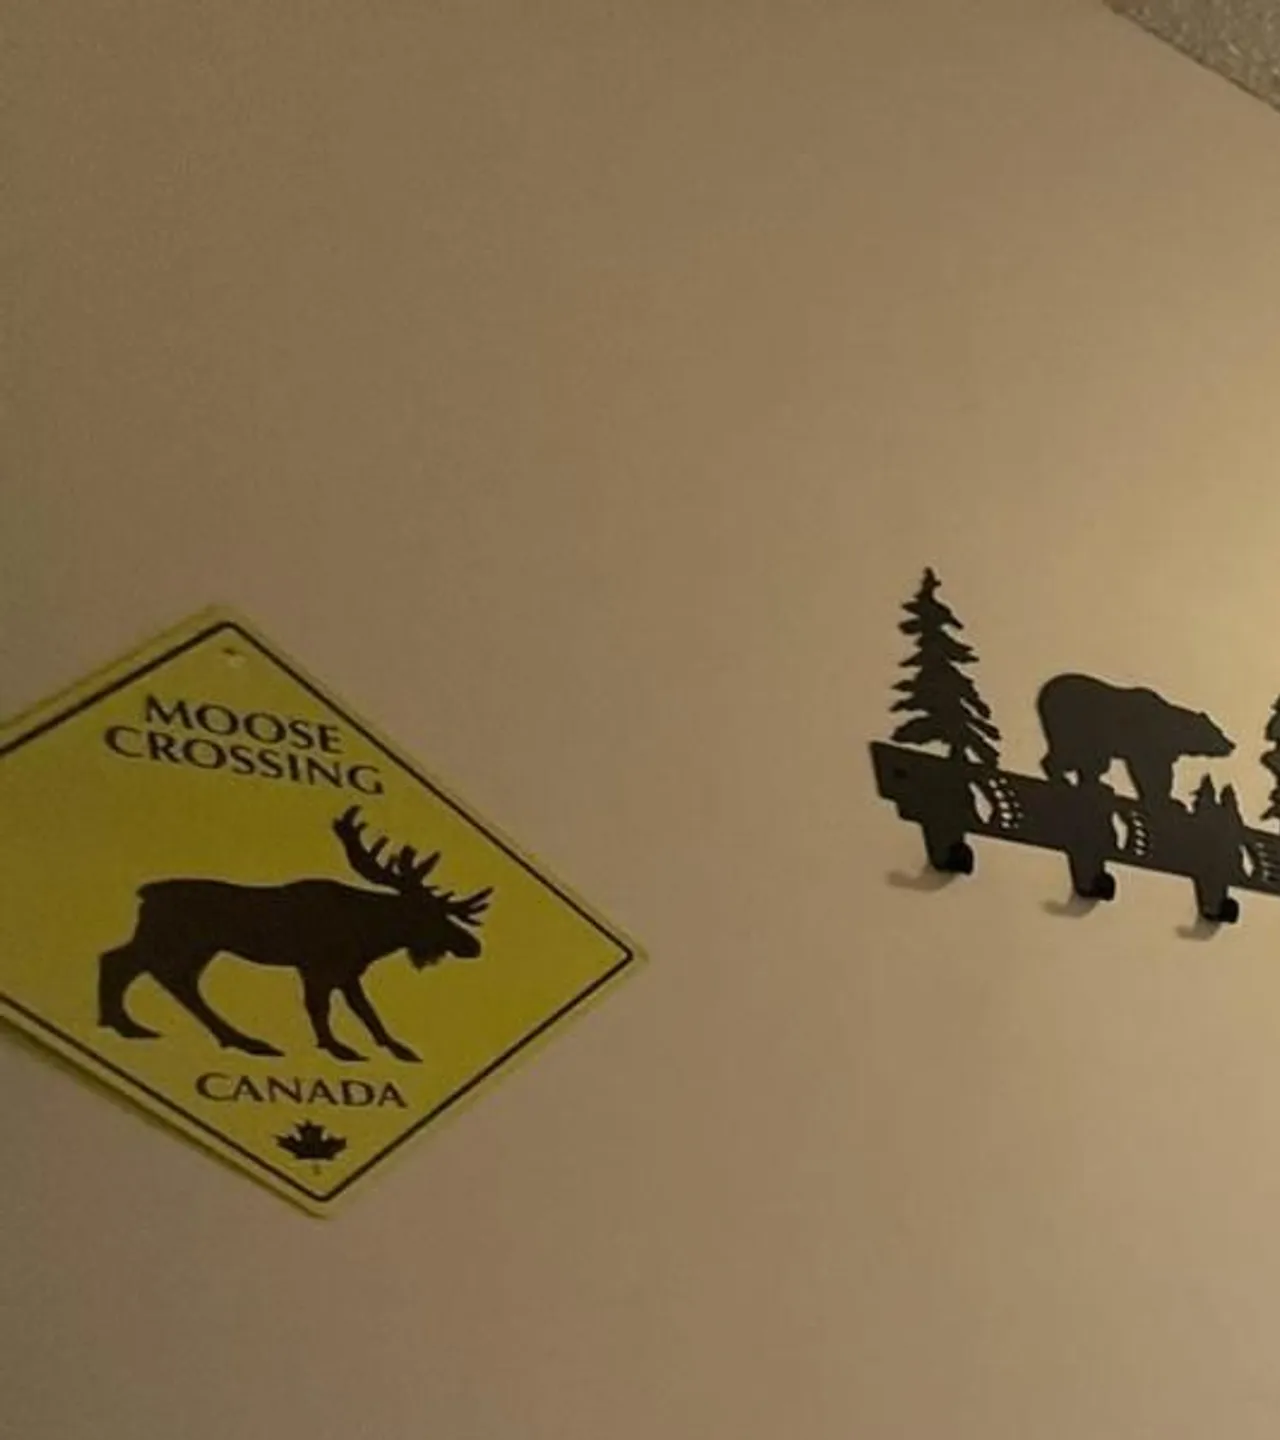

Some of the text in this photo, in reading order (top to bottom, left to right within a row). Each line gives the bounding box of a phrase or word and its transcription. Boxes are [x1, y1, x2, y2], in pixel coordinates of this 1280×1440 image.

[144, 695, 344, 754] MOOSE
[104, 725, 386, 796] CROSSING
[195, 1072, 408, 1109] CANADA
